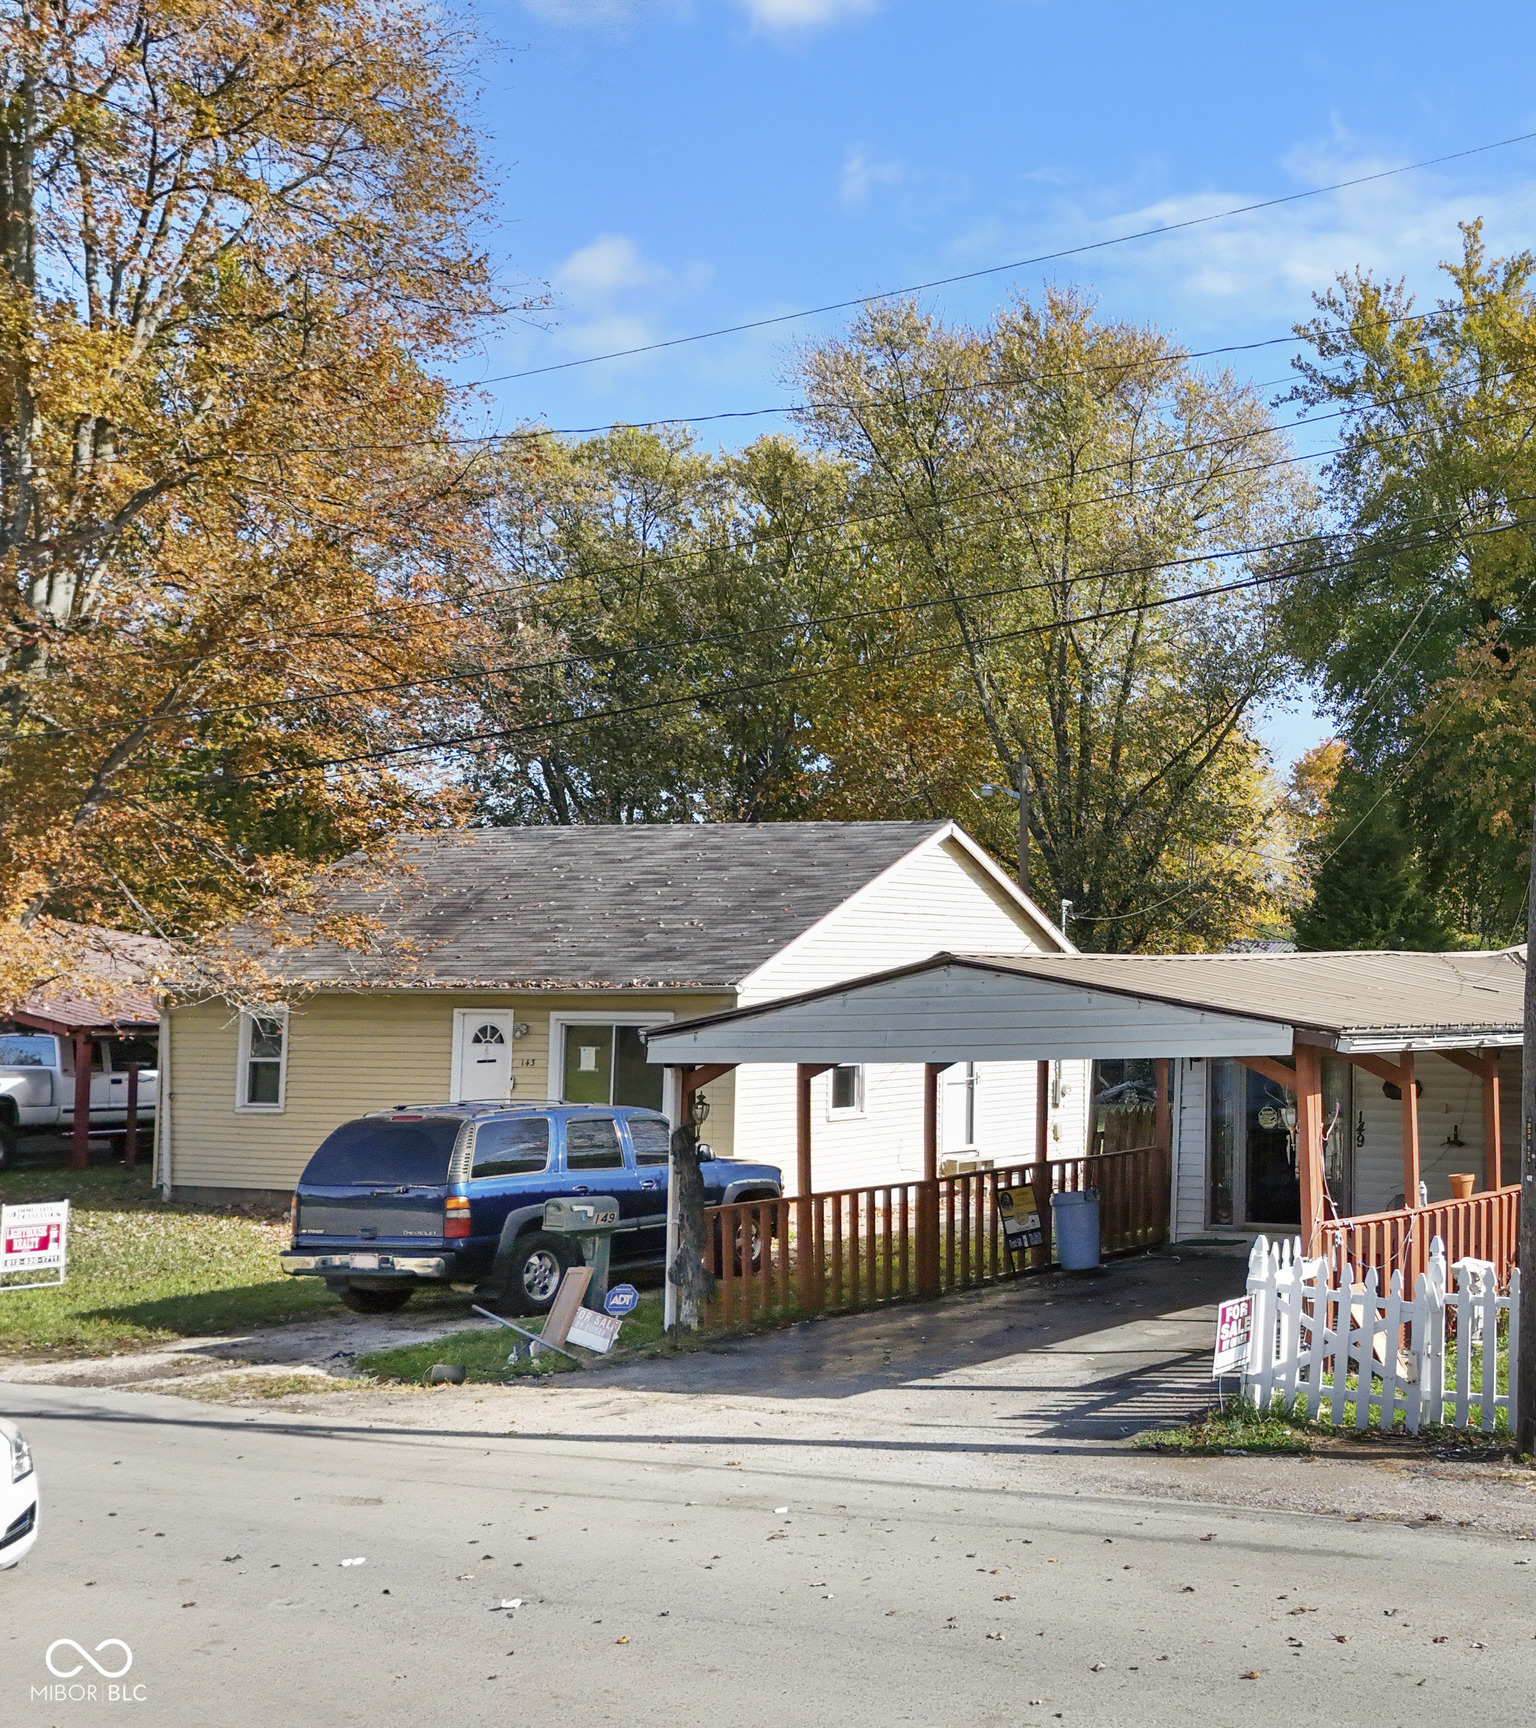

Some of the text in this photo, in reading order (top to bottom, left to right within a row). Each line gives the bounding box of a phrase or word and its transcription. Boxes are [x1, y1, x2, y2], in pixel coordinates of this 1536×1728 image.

[1356, 1110, 1366, 1148] 149
[594, 1212, 616, 1225] 149
[6, 1225, 48, 1240] LIGHTHOUSE
[13, 1237, 40, 1251] REALTY
[609, 1294, 634, 1305] ADT
[577, 1309, 592, 1323] OR
[1225, 1302, 1248, 1323] FOR
[1220, 1315, 1251, 1341] SALE
